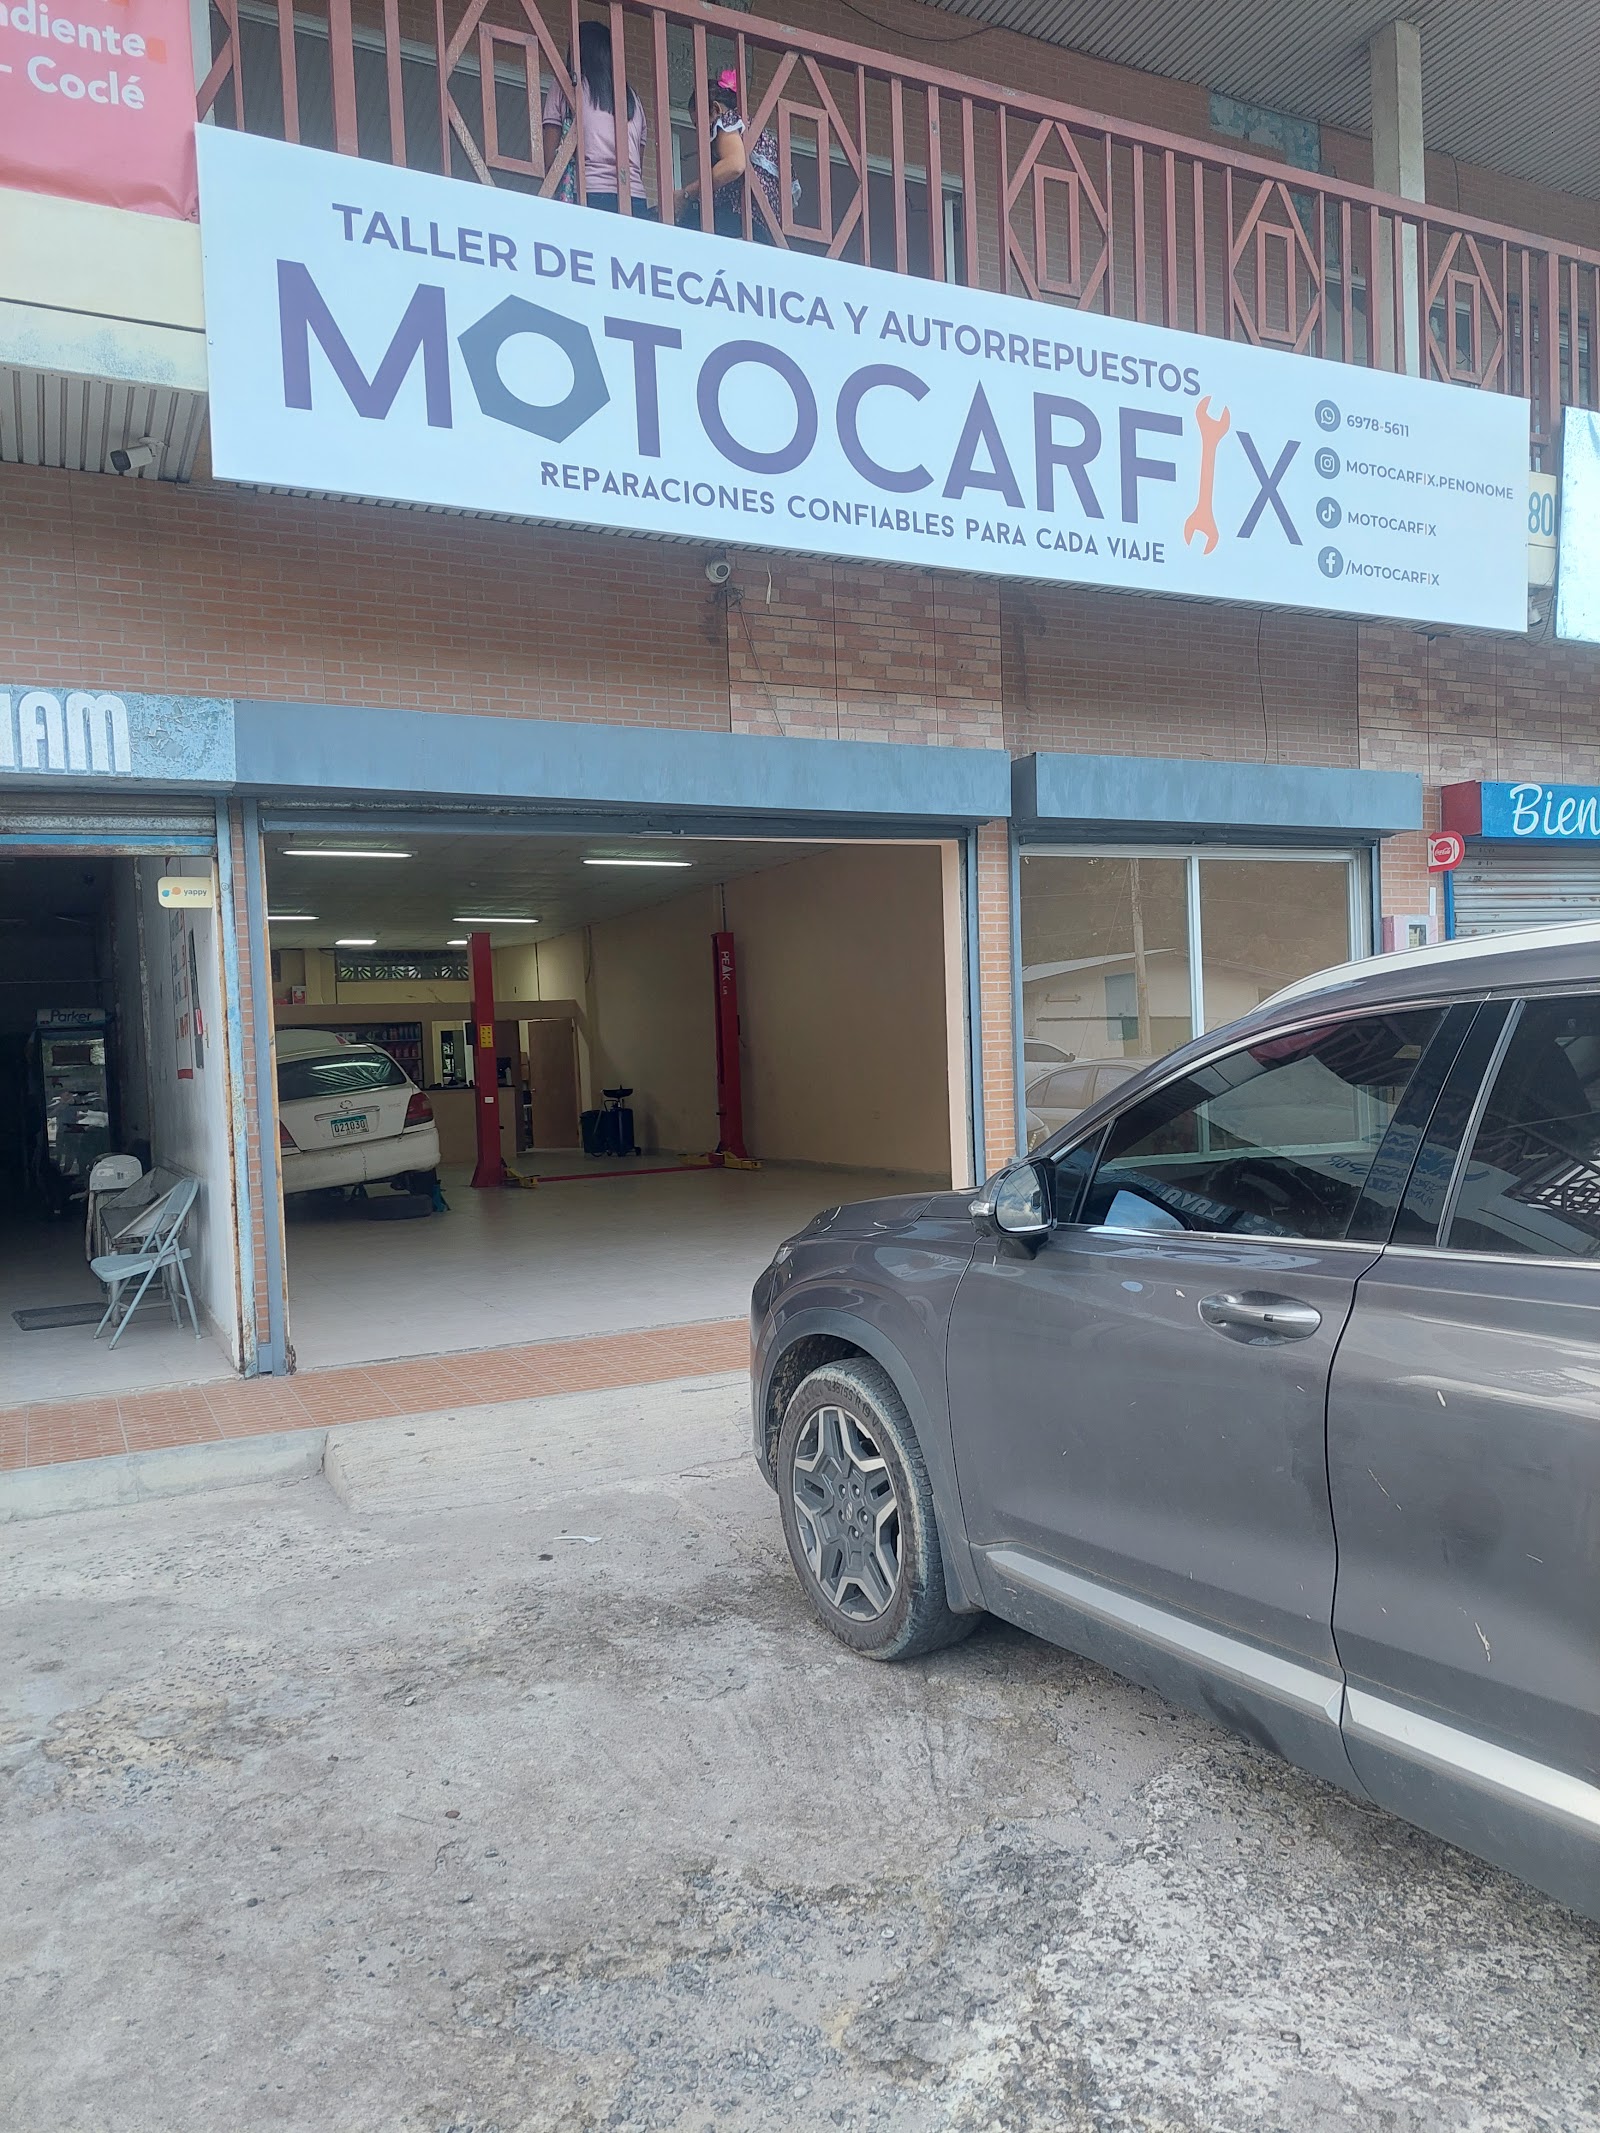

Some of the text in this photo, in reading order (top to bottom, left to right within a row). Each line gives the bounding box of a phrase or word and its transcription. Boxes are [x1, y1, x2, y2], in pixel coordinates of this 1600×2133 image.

[27, 56, 145, 109] Coclé
[332, 203, 1200, 396] TALLER DE MECÁNICA Y AUTORREPUESTOS
[277, 258, 1302, 555] MOTOCARFIX
[1346, 414, 1409, 437] 6978-5611
[1346, 460, 1514, 499] MOTOCARFIX.PENONOME
[541, 461, 1165, 563] REPARACIONES CONFIABLES PARA CADA VIAJE
[1348, 511, 1437, 536] MOTOCARFIX
[1528, 491, 1557, 537] 80
[1346, 560, 1440, 586] /MOTOCARFIX
[183, 888, 207, 896] yappy
[721, 951, 734, 981] PEAK
[50, 1009, 93, 1022] Parker
[333, 1119, 367, 1133] 021030
